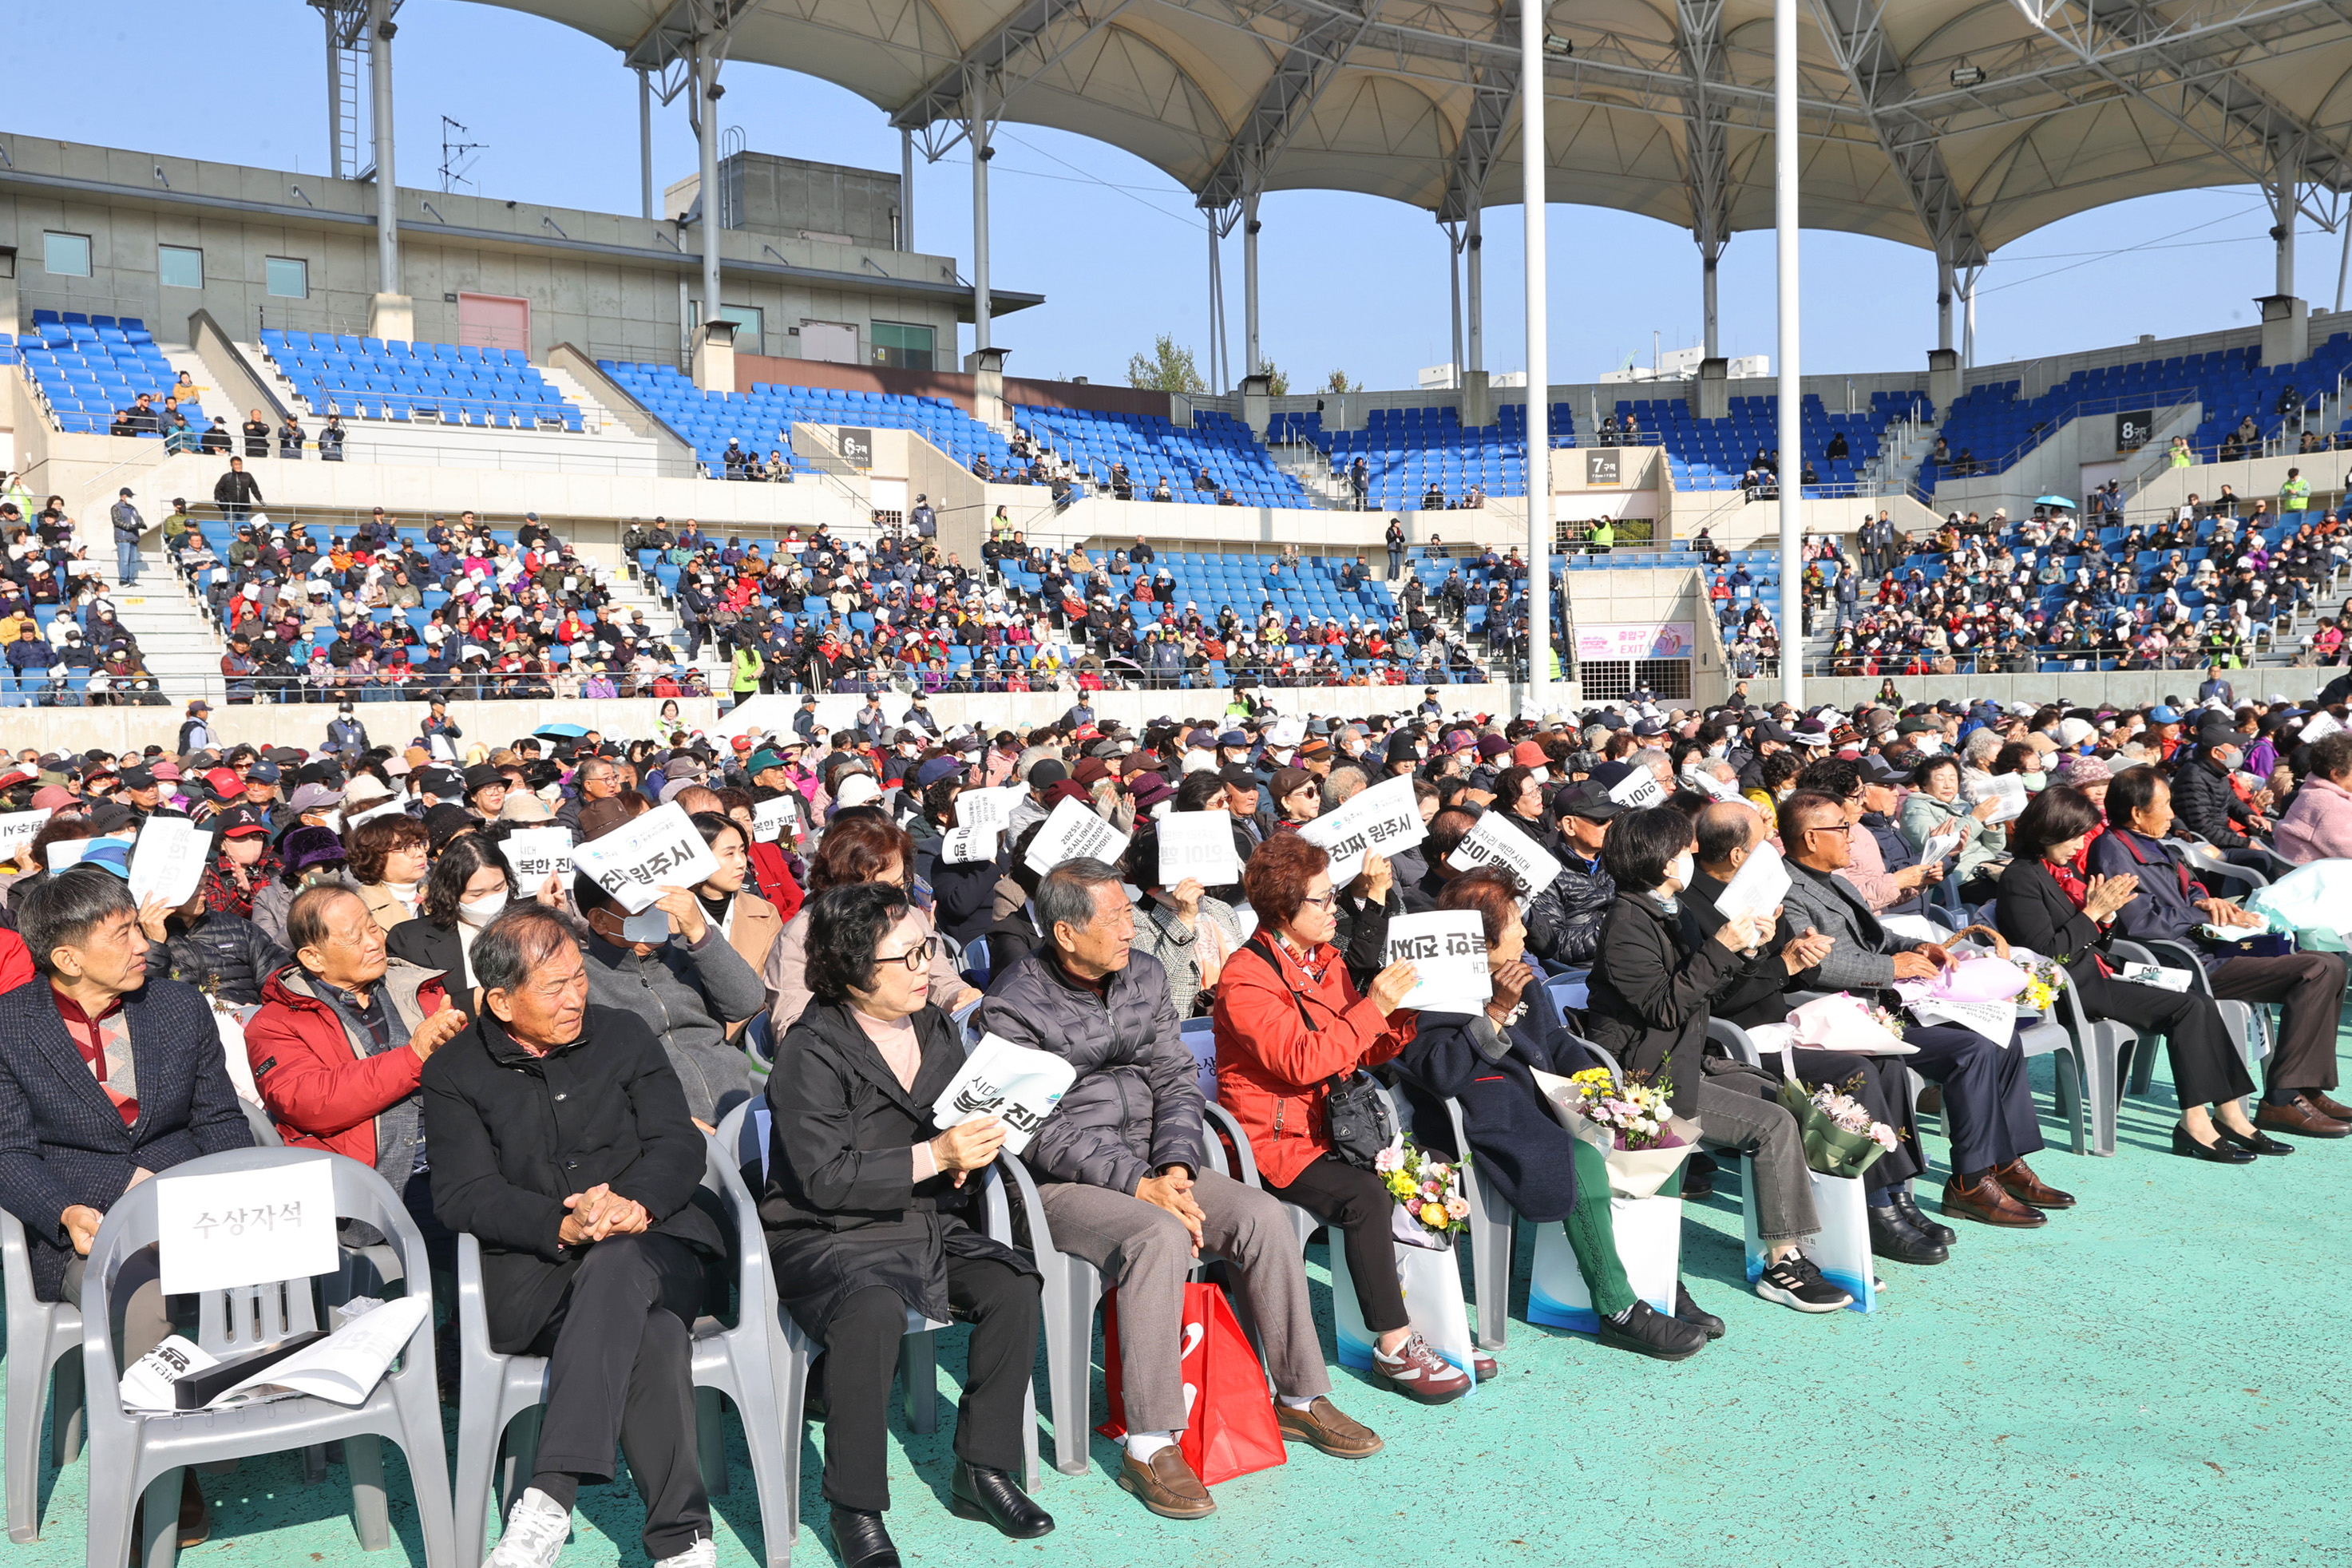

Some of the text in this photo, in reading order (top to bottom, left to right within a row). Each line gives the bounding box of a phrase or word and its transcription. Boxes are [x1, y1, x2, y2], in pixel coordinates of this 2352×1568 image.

[844, 437, 868, 455] 6구역
[1592, 457, 1617, 473] 7구역
[1618, 631, 1646, 641] 출입구
[1620, 644, 1645, 654] EXIT
[240, 810, 255, 823] A
[1060, 820, 1083, 845] 2025년
[1061, 816, 1099, 861] 원주시니어클럽
[1329, 813, 1412, 863] 진짜 원주시
[1471, 824, 1531, 872] 일자리 백만시대
[632, 839, 695, 885] 원주시
[1389, 934, 1439, 963] 진짜
[972, 1075, 1002, 1097] 시대
[192, 1201, 303, 1239] 수상자석
